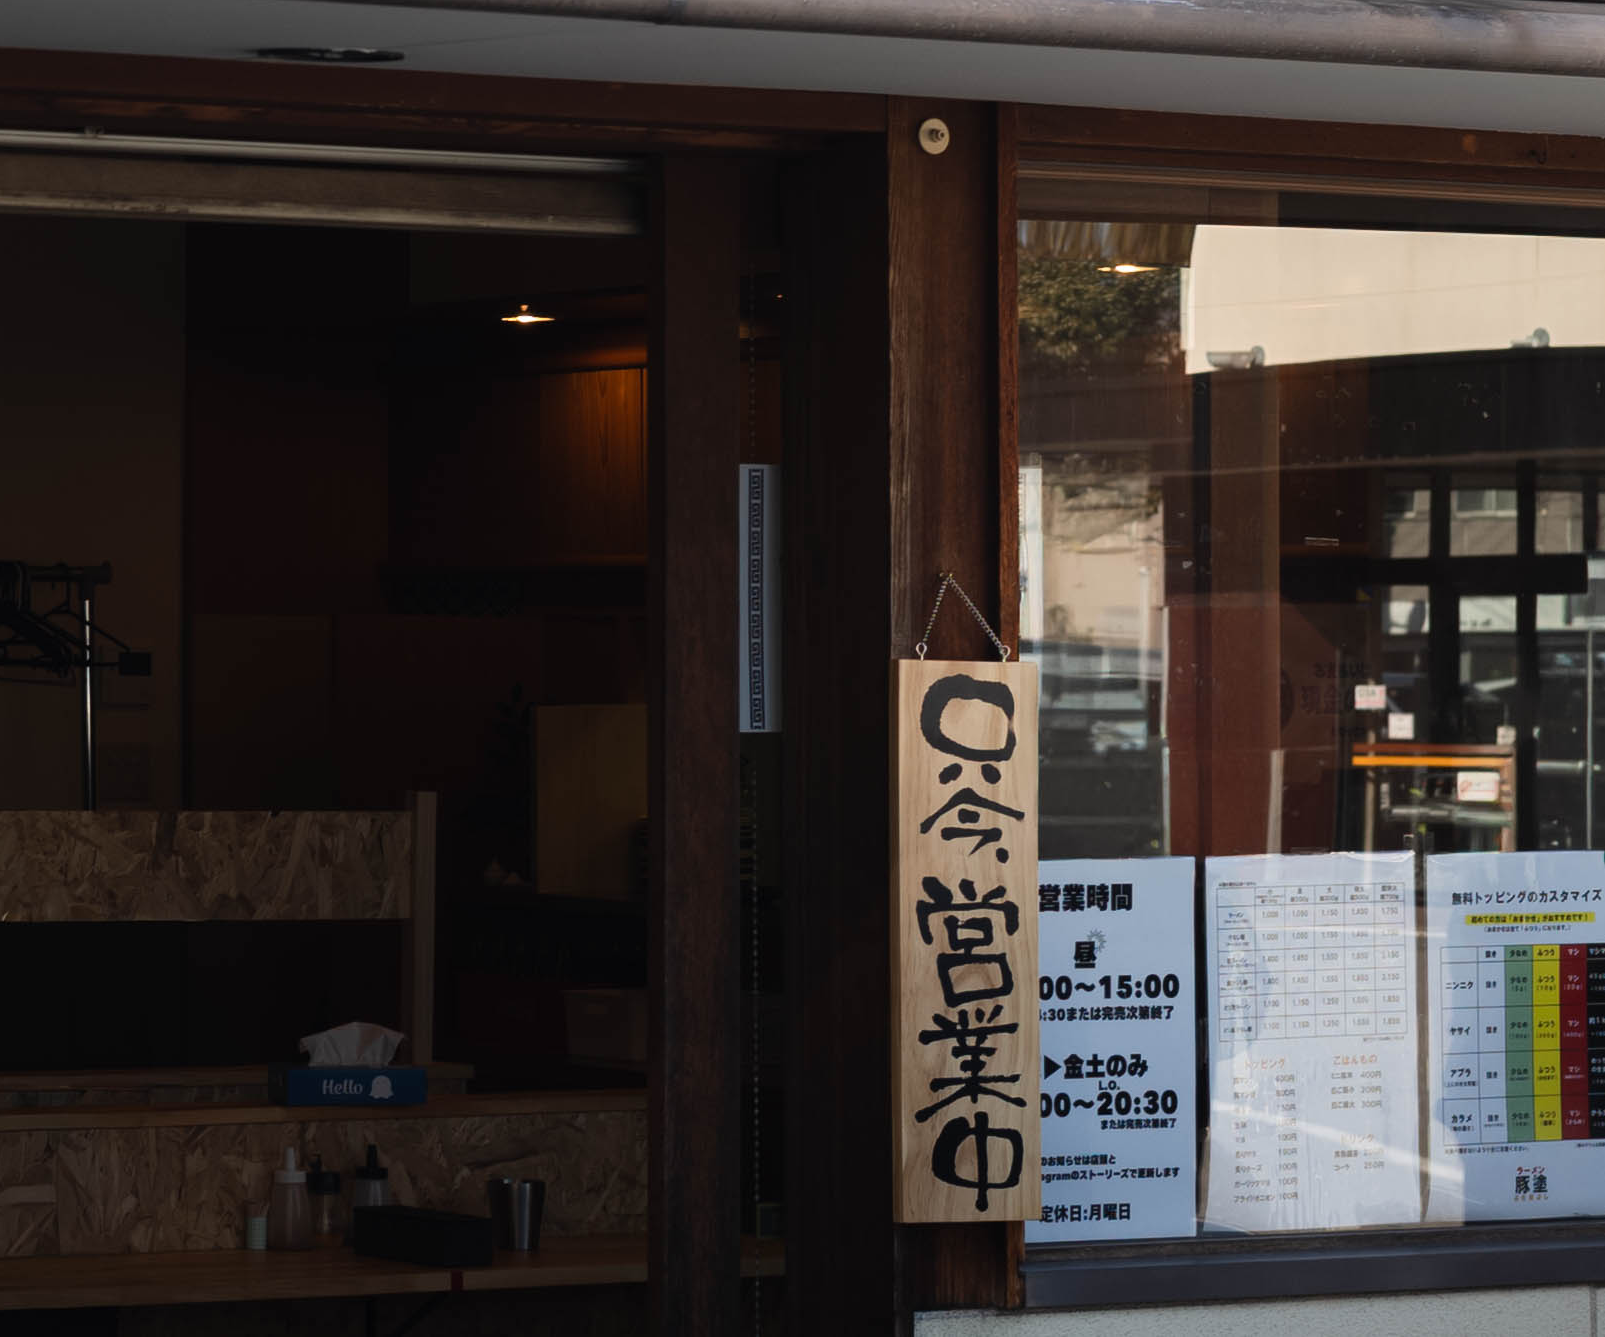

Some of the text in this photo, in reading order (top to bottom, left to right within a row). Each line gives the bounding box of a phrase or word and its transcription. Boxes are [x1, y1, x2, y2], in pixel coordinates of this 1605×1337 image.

[1038, 883, 1133, 912] 営業時間
[1452, 889, 1602, 905] 無料トッピングのカスタマイズ
[1073, 941, 1097, 969] 昼
[1446, 982, 1473, 990] ニンニク
[1039, 1005, 1174, 1022] :30または完売次第終了
[322, 1078, 364, 1095] Hello
[1098, 1081, 1121, 1091] L.O.
[1516, 1166, 1545, 1175] ラーメン
[1515, 1175, 1548, 1194] 豚塗
